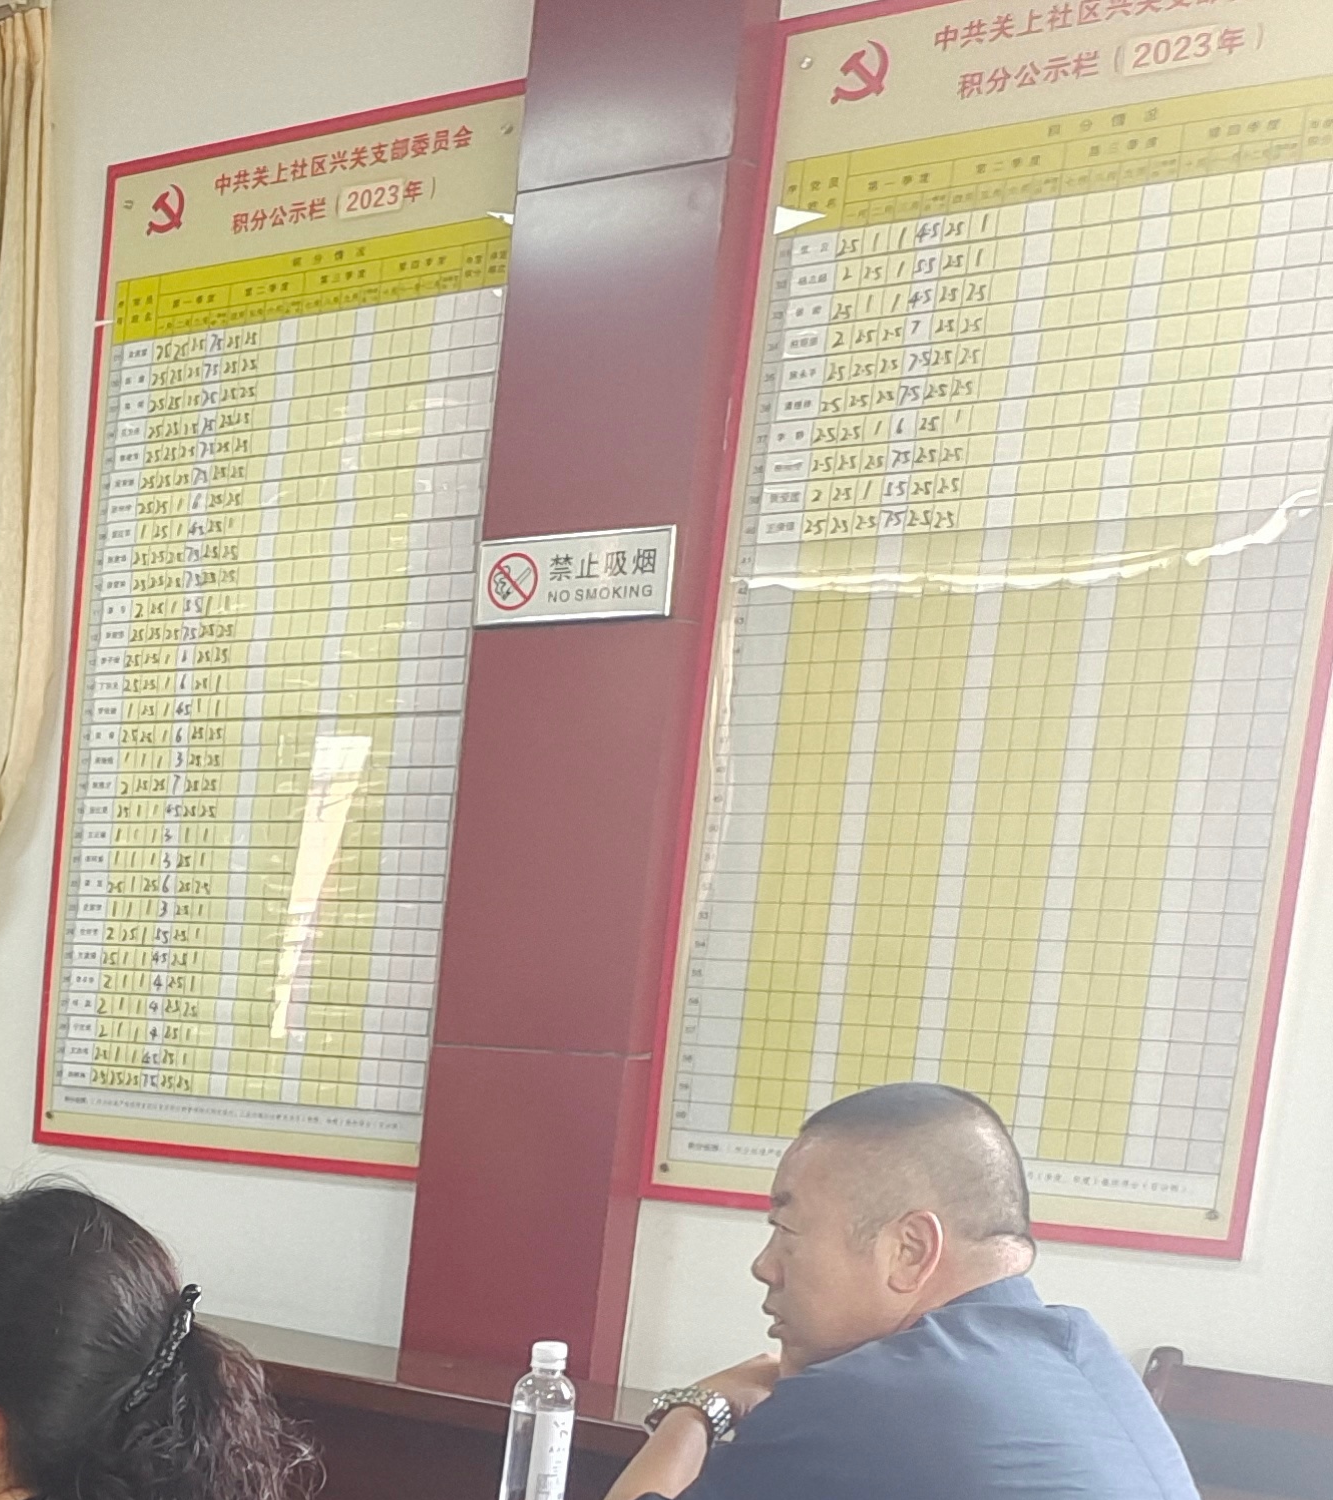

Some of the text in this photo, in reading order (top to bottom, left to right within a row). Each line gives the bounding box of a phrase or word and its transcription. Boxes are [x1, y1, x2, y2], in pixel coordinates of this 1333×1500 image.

[214, 124, 474, 197] 中共关上社区兴关支部委员会
[549, 548, 657, 582] 禁止吸烟
[547, 584, 653, 603] NO SMOKING
